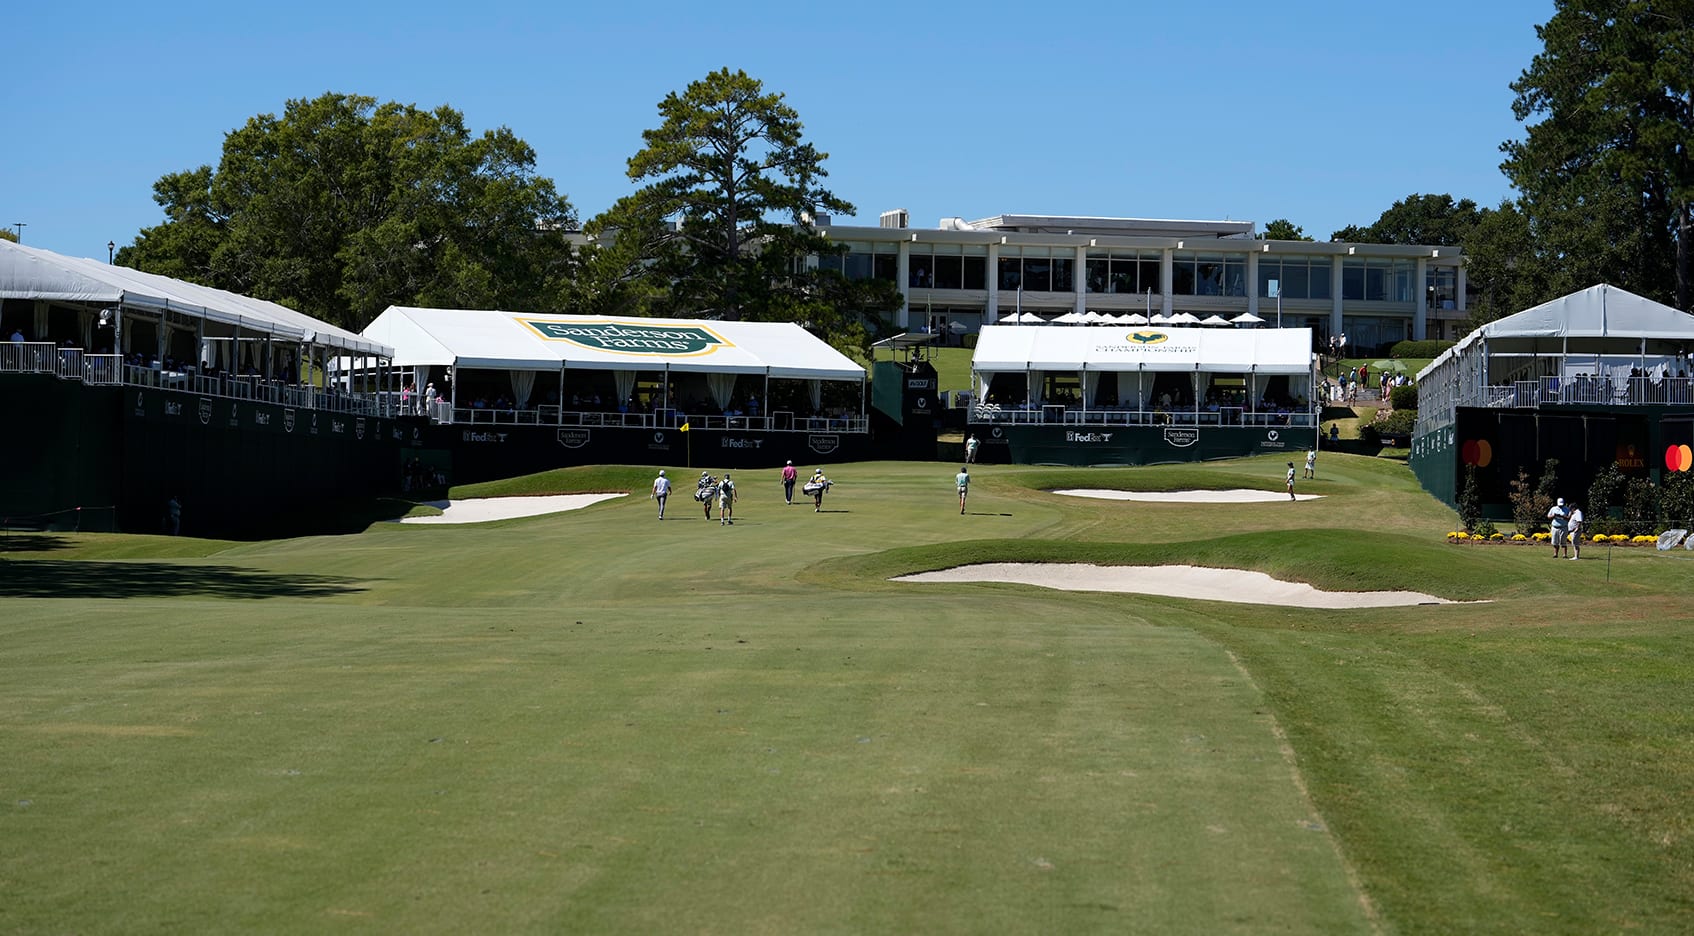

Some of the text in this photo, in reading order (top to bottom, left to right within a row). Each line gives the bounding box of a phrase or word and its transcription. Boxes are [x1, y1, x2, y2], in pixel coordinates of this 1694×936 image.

[547, 325, 706, 340] Sanderson
[591, 336, 688, 350] Farms
[1074, 432, 1101, 442] FedEx
[1618, 458, 1645, 468] ROLEX
